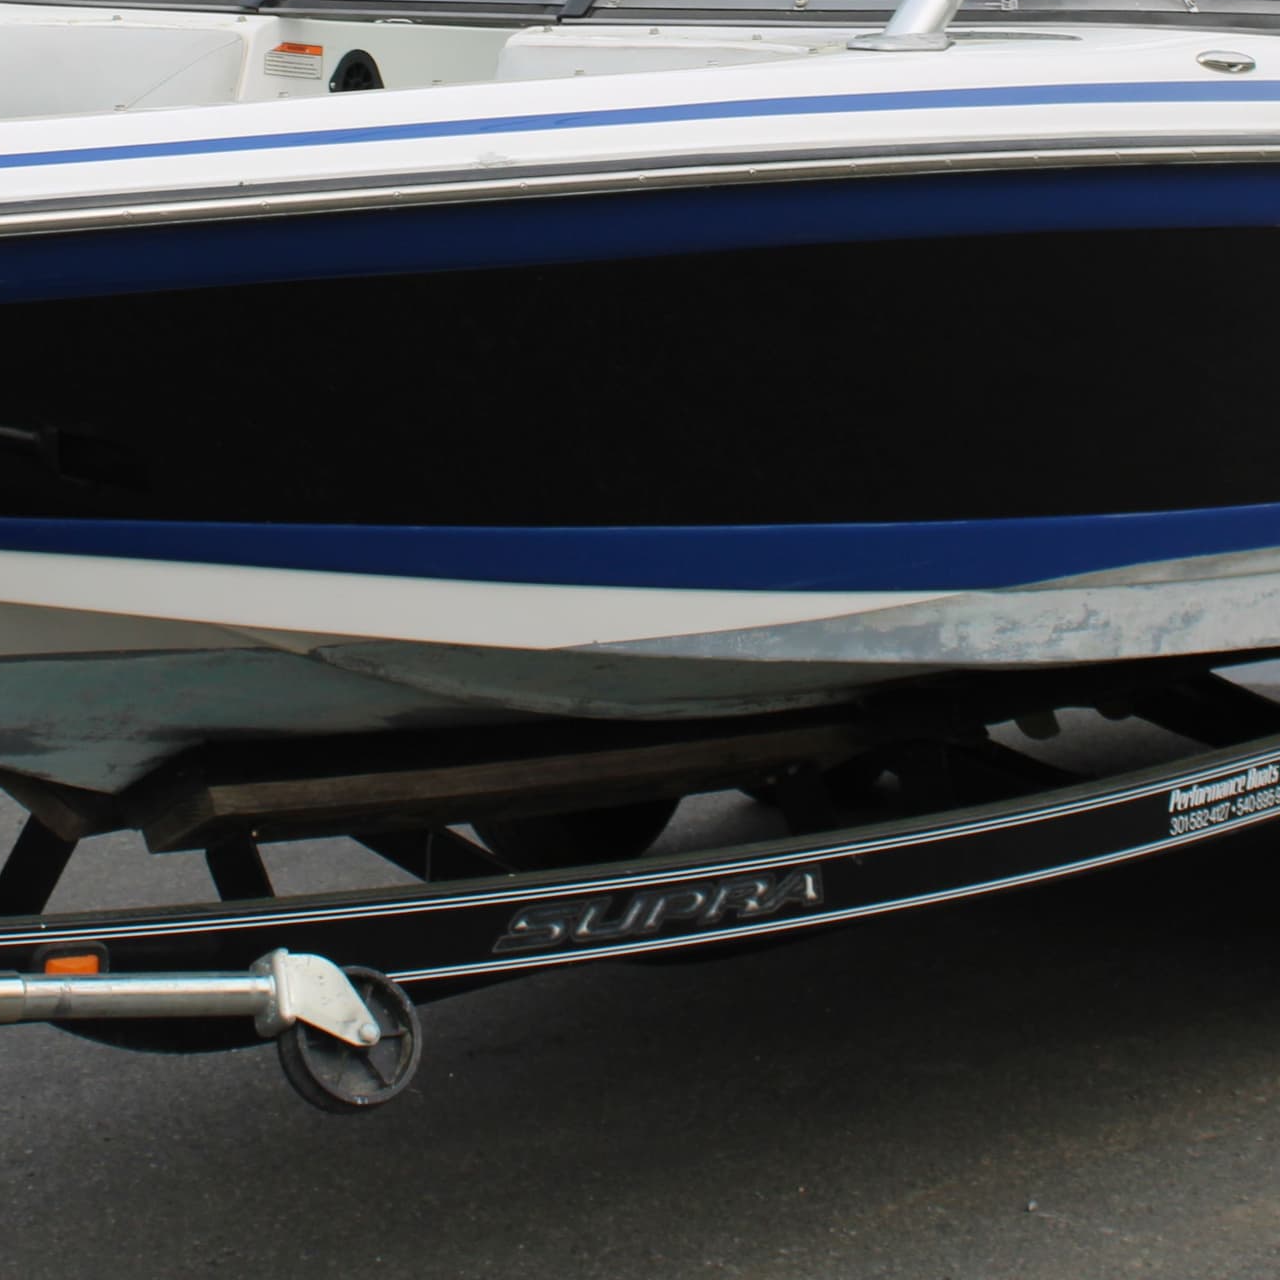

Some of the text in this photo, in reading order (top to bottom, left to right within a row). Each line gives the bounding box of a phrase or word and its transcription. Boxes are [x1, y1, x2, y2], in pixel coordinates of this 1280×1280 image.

[1169, 773, 1247, 813] Performance
[1246, 764, 1280, 791] Boats
[492, 868, 824, 953] SUPRA
